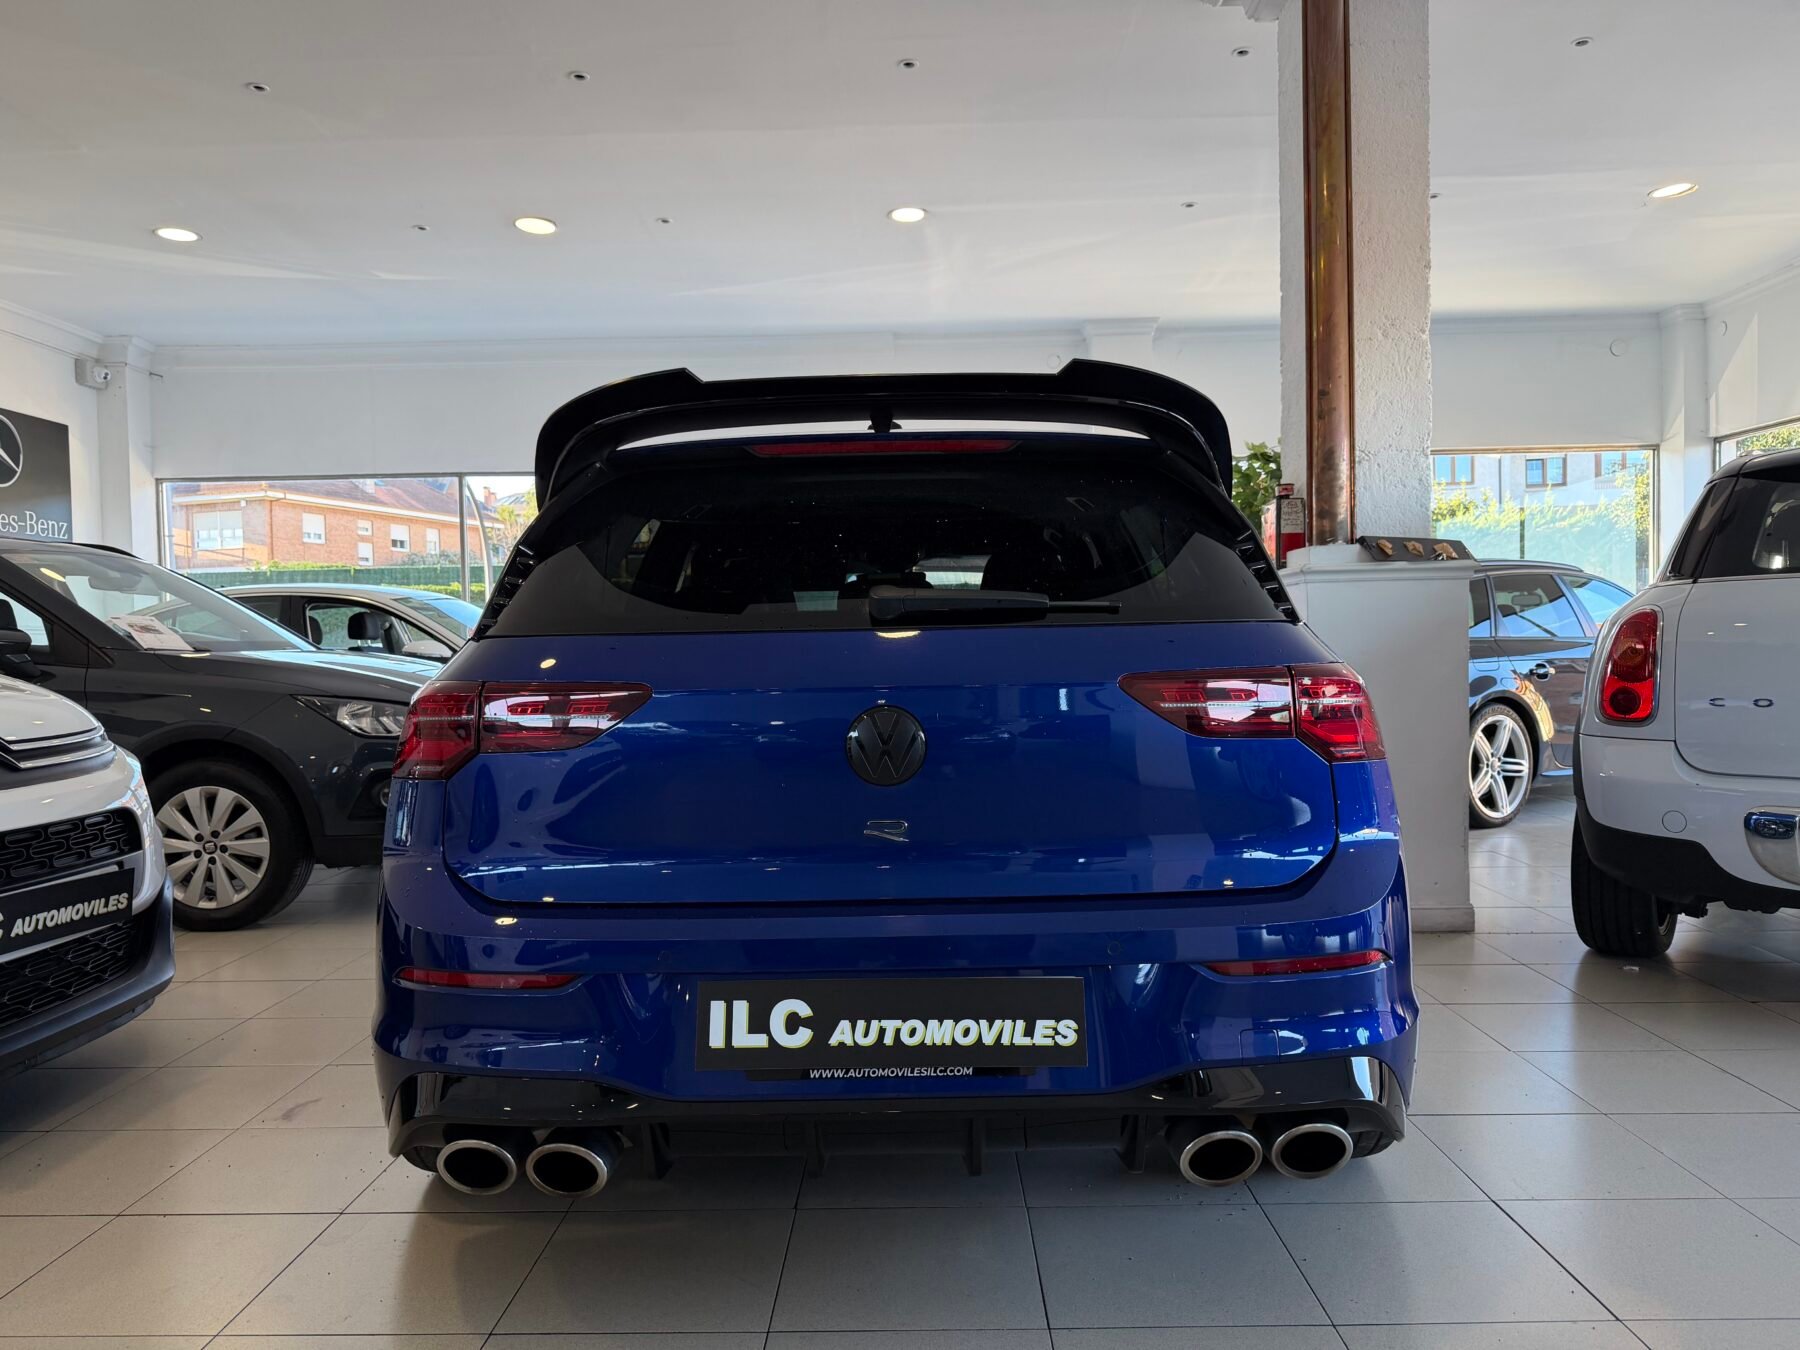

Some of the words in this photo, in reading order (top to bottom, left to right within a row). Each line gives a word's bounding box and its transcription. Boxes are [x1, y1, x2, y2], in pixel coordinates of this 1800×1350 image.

[10, 892, 129, 938] AUTOMOVILES
[708, 999, 814, 1049] ILC
[828, 1018, 1079, 1047] AUTOMOVILES
[809, 1066, 973, 1079] WWW.AUTOMOVILESILC.COM
